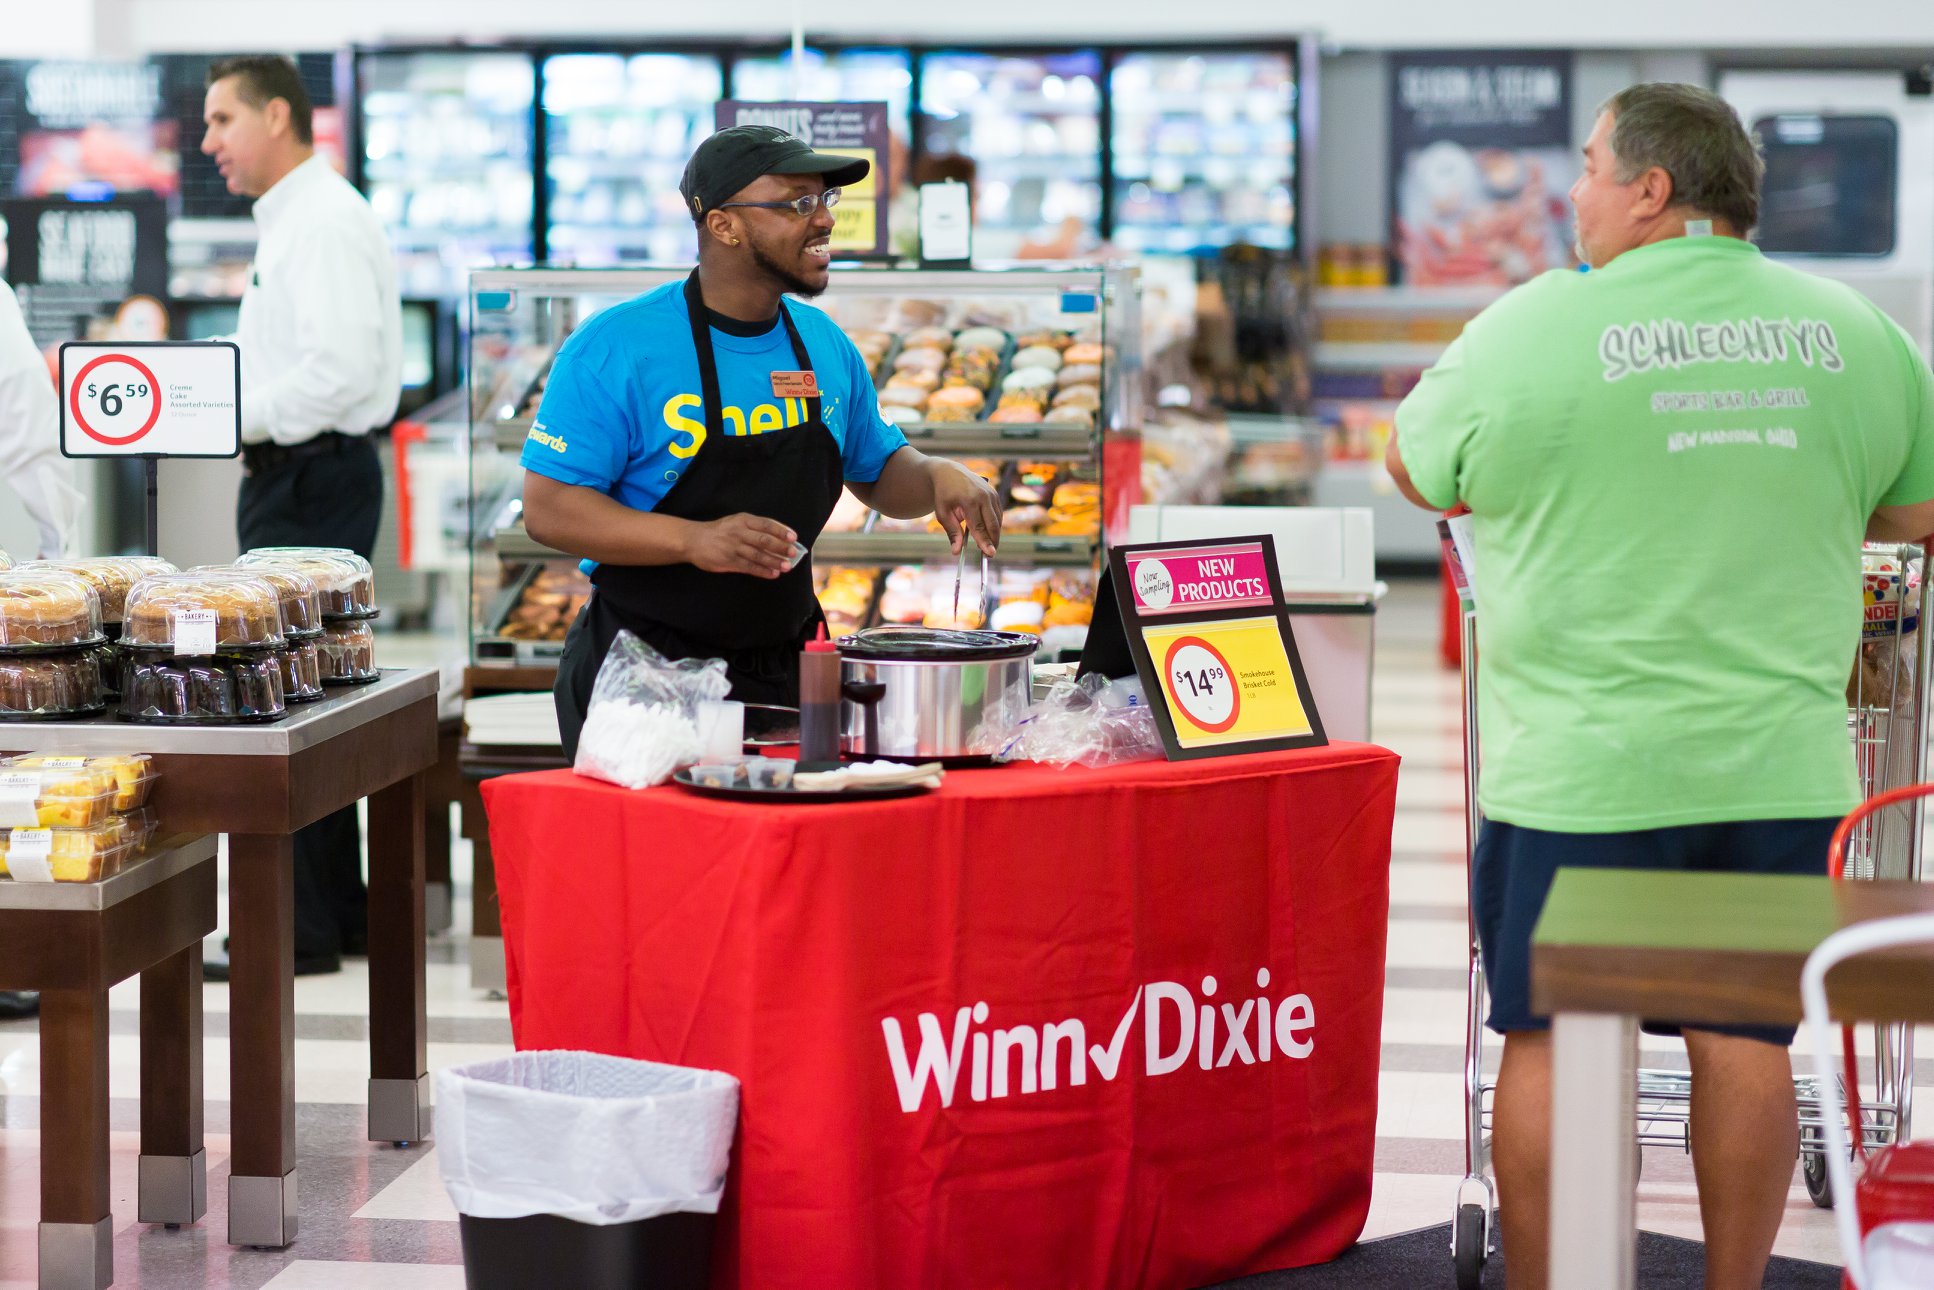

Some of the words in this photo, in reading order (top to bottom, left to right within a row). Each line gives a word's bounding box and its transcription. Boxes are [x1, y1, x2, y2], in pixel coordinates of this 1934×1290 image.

[1599, 317, 1843, 381] SCHLECHTY'S
[1651, 391, 1709, 412] SPORTS
[1711, 390, 1746, 409] BAR
[1764, 387, 1810, 408] GRILL
[1143, 572, 1158, 584] Now
[1197, 558, 1235, 578] NEW
[1139, 580, 1170, 597] Sampling
[1178, 577, 1264, 601] PRODUCTS
[1239, 670, 1275, 679] Smokehouse
[1243, 681, 1262, 689] Brisket
[881, 1001, 1087, 1113] Winn
[1145, 967, 1315, 1077] Dixie
